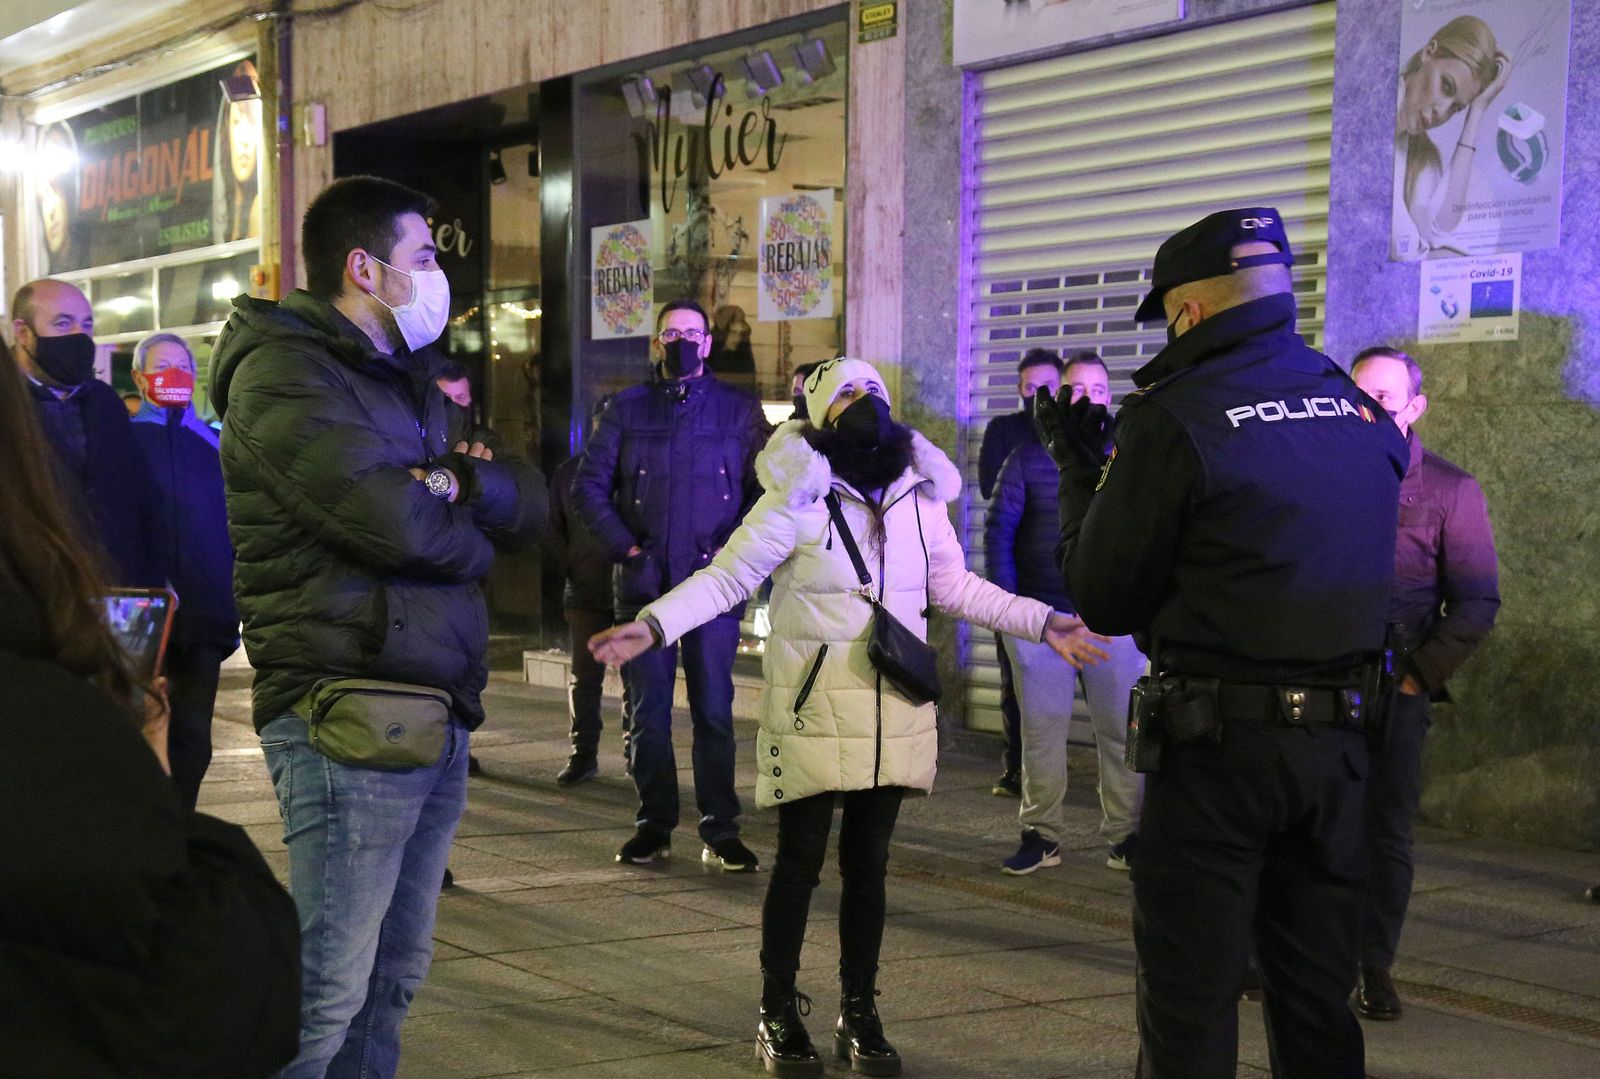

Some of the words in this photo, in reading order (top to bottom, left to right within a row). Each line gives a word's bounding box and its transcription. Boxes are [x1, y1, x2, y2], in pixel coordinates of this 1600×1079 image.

[79, 128, 214, 221] DIAGONAL
[1507, 194, 1552, 206] constante
[1240, 217, 1274, 229] CNP
[1468, 211, 1487, 222] para
[1489, 209, 1502, 219] tus
[1504, 208, 1534, 217] manos
[765, 239, 831, 273] REBAJAS
[597, 262, 650, 296] REBAJAS
[1469, 267, 1513, 279] Covid-19
[1225, 397, 1361, 428] POLICIA
